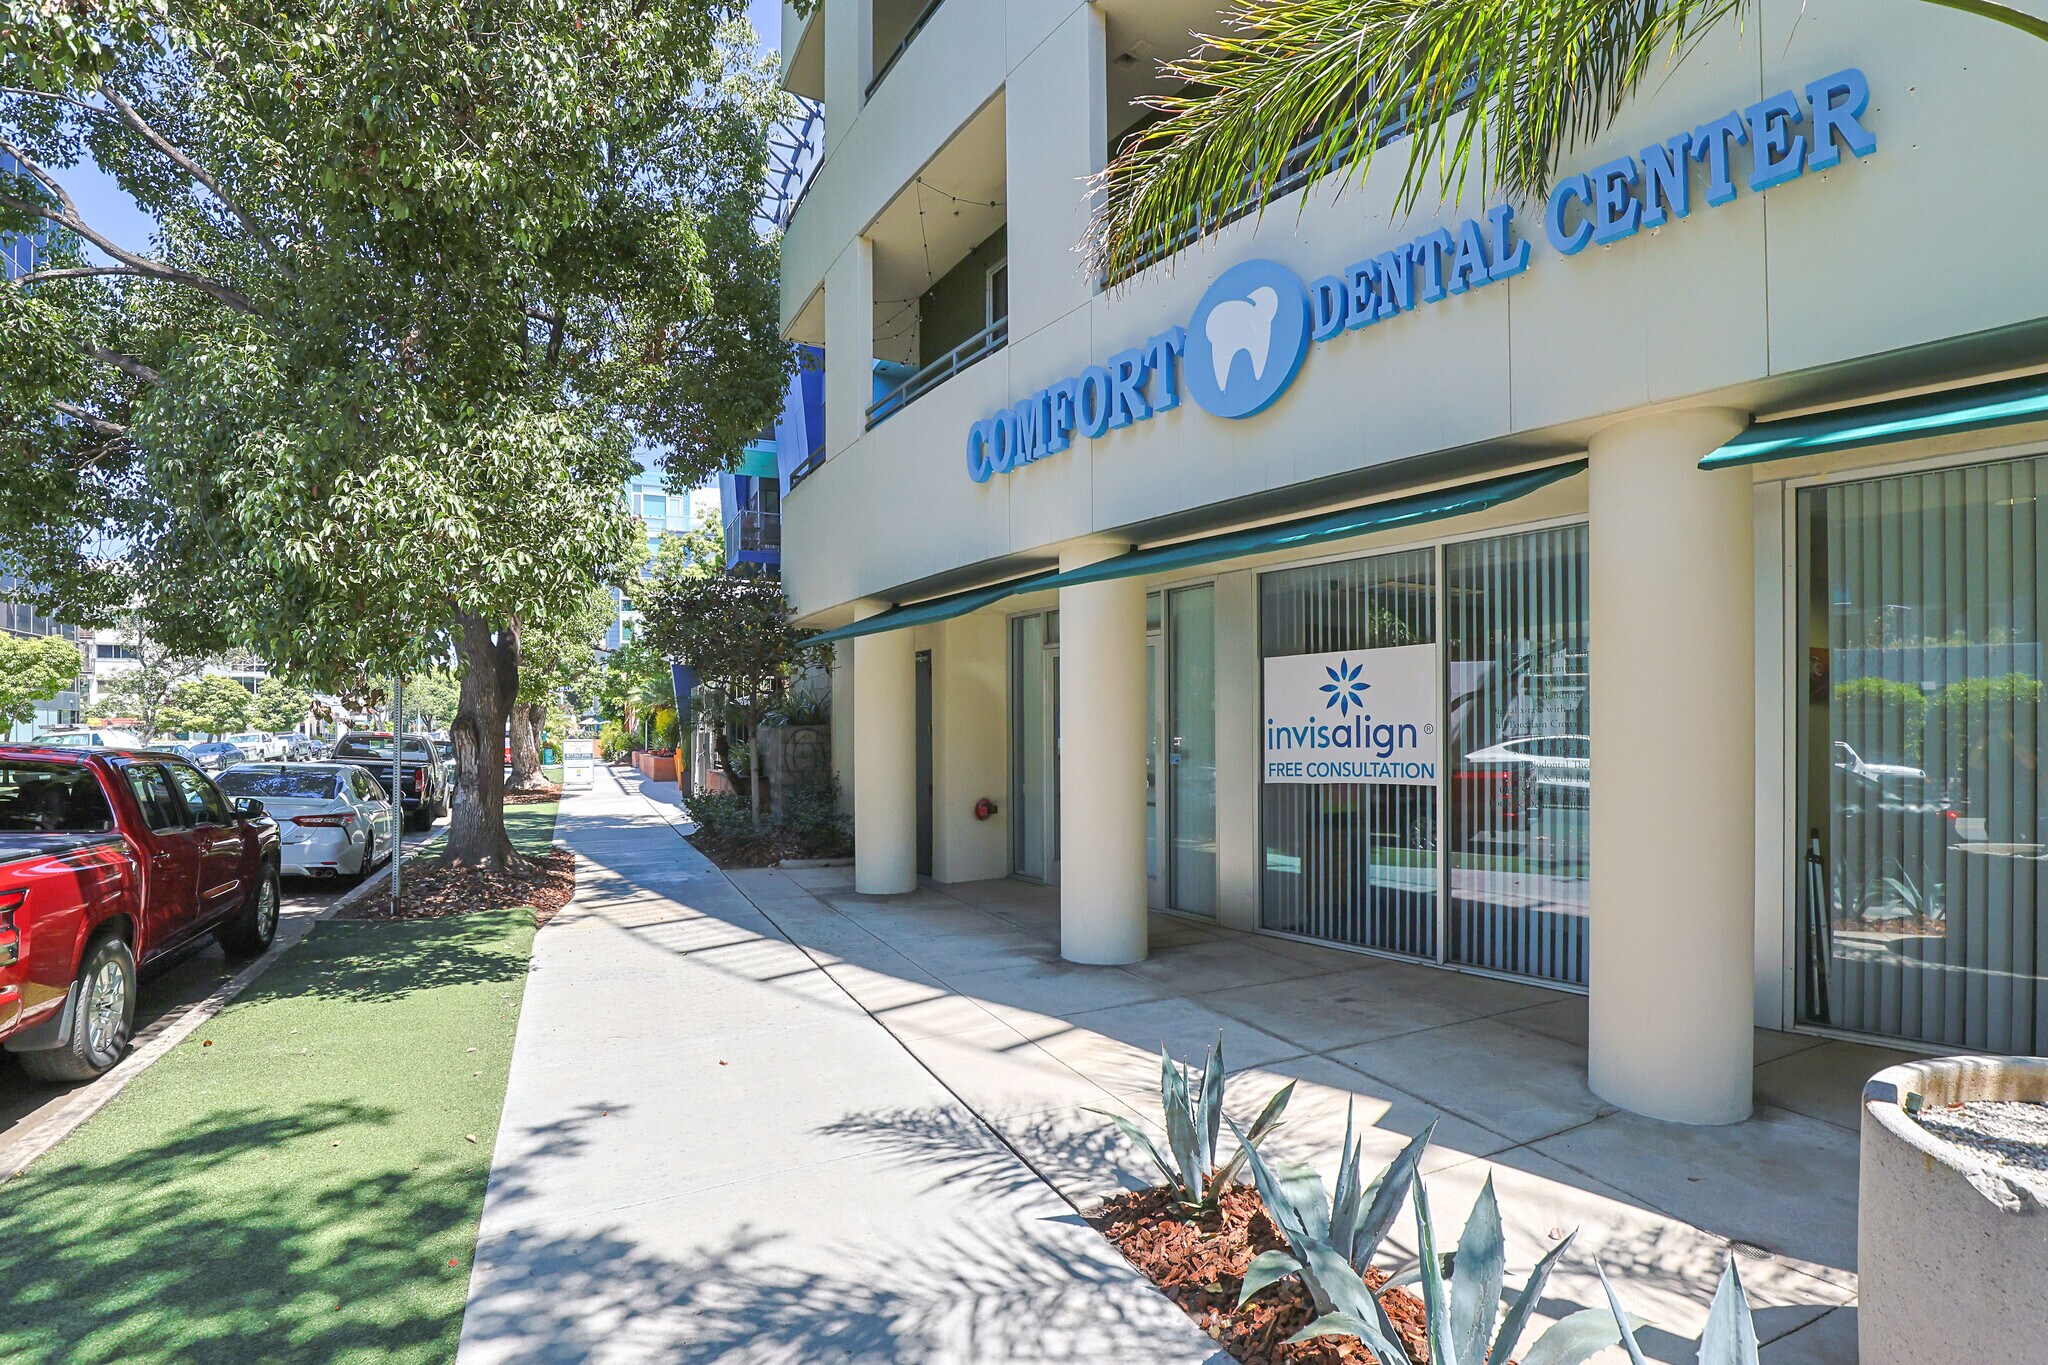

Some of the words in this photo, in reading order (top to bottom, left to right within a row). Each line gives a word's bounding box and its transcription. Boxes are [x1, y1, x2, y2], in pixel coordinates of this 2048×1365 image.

[967, 325, 1184, 483] COMFORT
[1309, 204, 1531, 342] DENTAL
[1546, 68, 1876, 255] CENTER
[1492, 705, 1517, 717] igital
[1546, 704, 1566, 713] with
[1268, 715, 1417, 758] invisalign
[1269, 762, 1302, 777] FREE
[1306, 762, 1434, 778] CONSULTATION
[1543, 774, 1552, 782] &
[1555, 774, 1570, 782] Full
